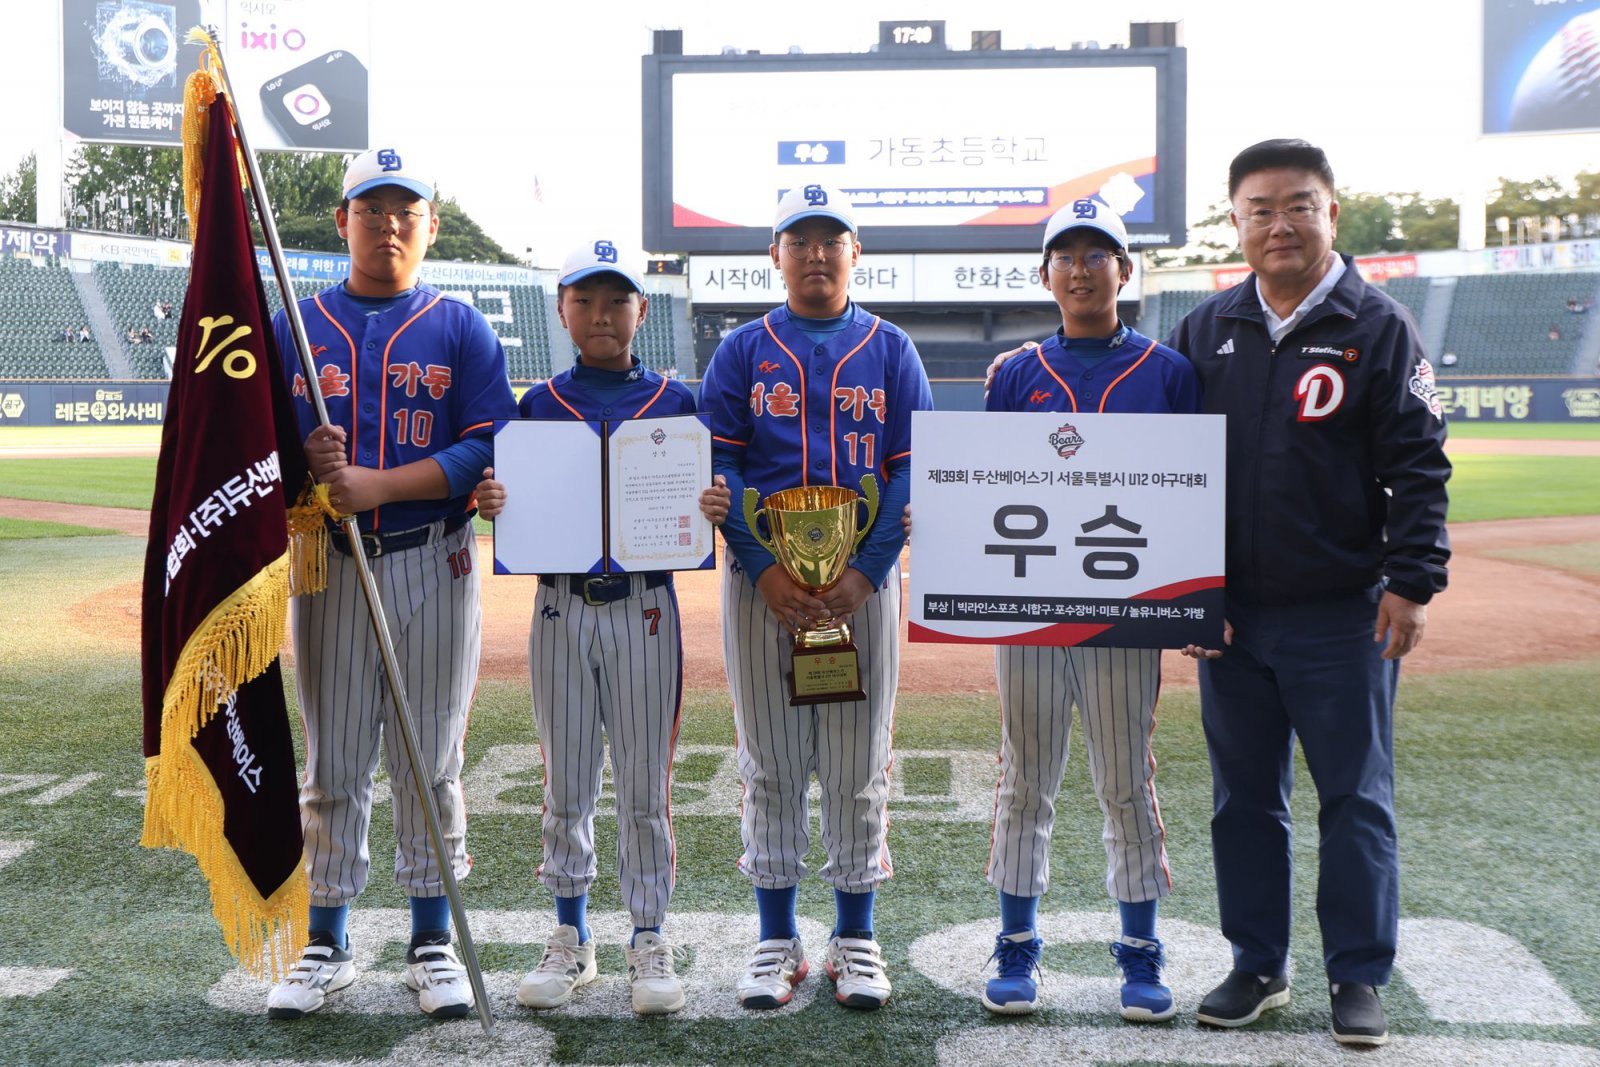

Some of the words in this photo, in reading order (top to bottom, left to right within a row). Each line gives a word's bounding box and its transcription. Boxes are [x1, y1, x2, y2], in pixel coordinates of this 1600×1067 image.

[89, 98, 124, 114] 보이지
[103, 113, 126, 128] 가전
[869, 136, 1049, 167] 가동초등학교
[101, 244, 119, 255] KB
[312, 258, 334, 272] 위한
[337, 261, 349, 272] IT
[420, 265, 529, 283] 두산디지털이노베이션
[705, 268, 772, 290] 시작에
[848, 267, 898, 290] 하다
[388, 361, 452, 400] 가동
[1293, 363, 1346, 422] D
[393, 408, 434, 448] 10
[843, 432, 875, 468] 11
[1048, 432, 1085, 447] Bears
[928, 469, 969, 485] 제39회
[972, 469, 1054, 486] 두산베어스기
[1057, 471, 1126, 487] 서울특별시
[1129, 473, 1149, 486] U12
[1152, 472, 1208, 488] 야구대회
[447, 547, 472, 580] 10
[928, 602, 949, 614] 부상
[957, 602, 1019, 615] 빅라인스포츠
[1183, 607, 1206, 620] 가방
[644, 608, 661, 636] 7
